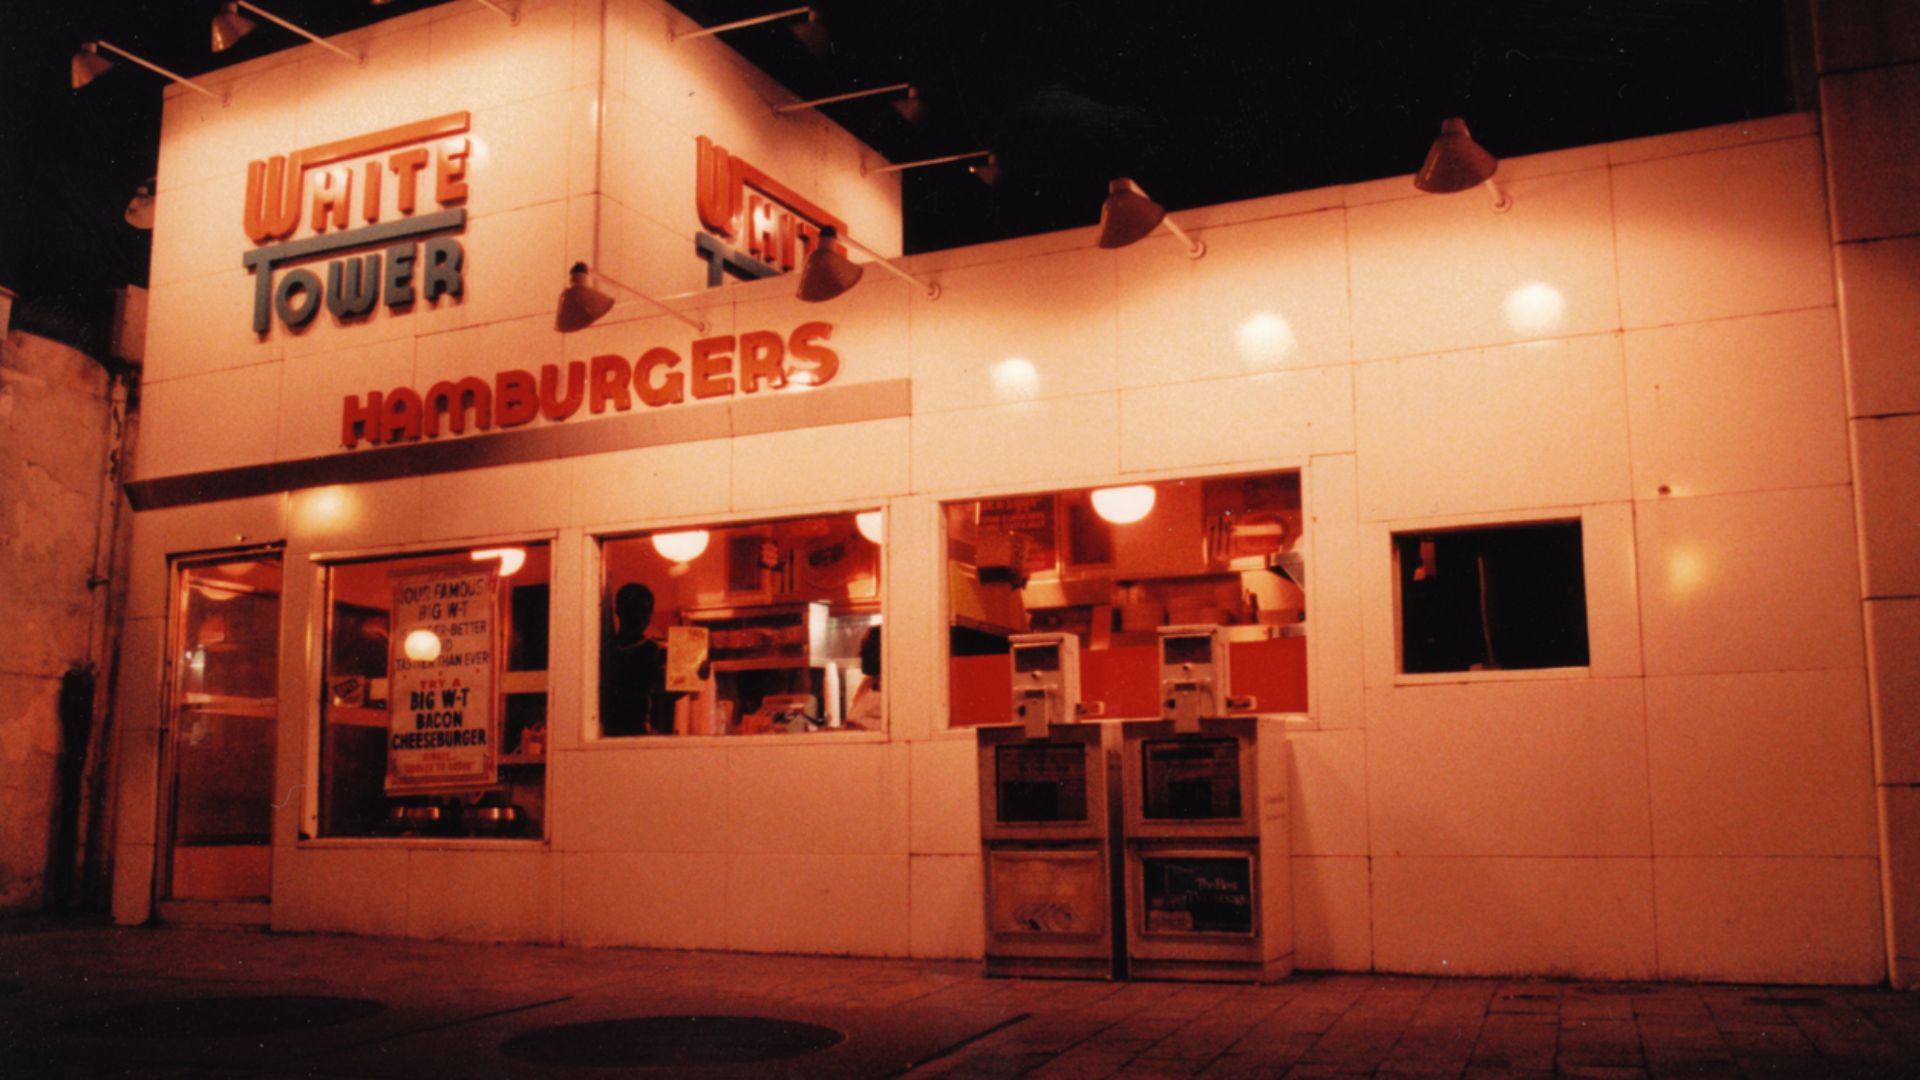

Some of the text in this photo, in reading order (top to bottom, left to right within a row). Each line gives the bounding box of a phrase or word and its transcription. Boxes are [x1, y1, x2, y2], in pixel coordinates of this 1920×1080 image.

[243, 110, 471, 245] WHITE
[696, 135, 848, 272] WHIT
[242, 207, 468, 340] TOWER
[341, 321, 840, 448] HAMBURGERS
[434, 578, 485, 599] FAMOUS
[464, 650, 489, 666] EVER
[420, 677, 461, 690] TRY A
[410, 687, 471, 711] BIG W-T
[416, 711, 463, 730] BACON
[391, 729, 487, 750] CHEESEBURGER
